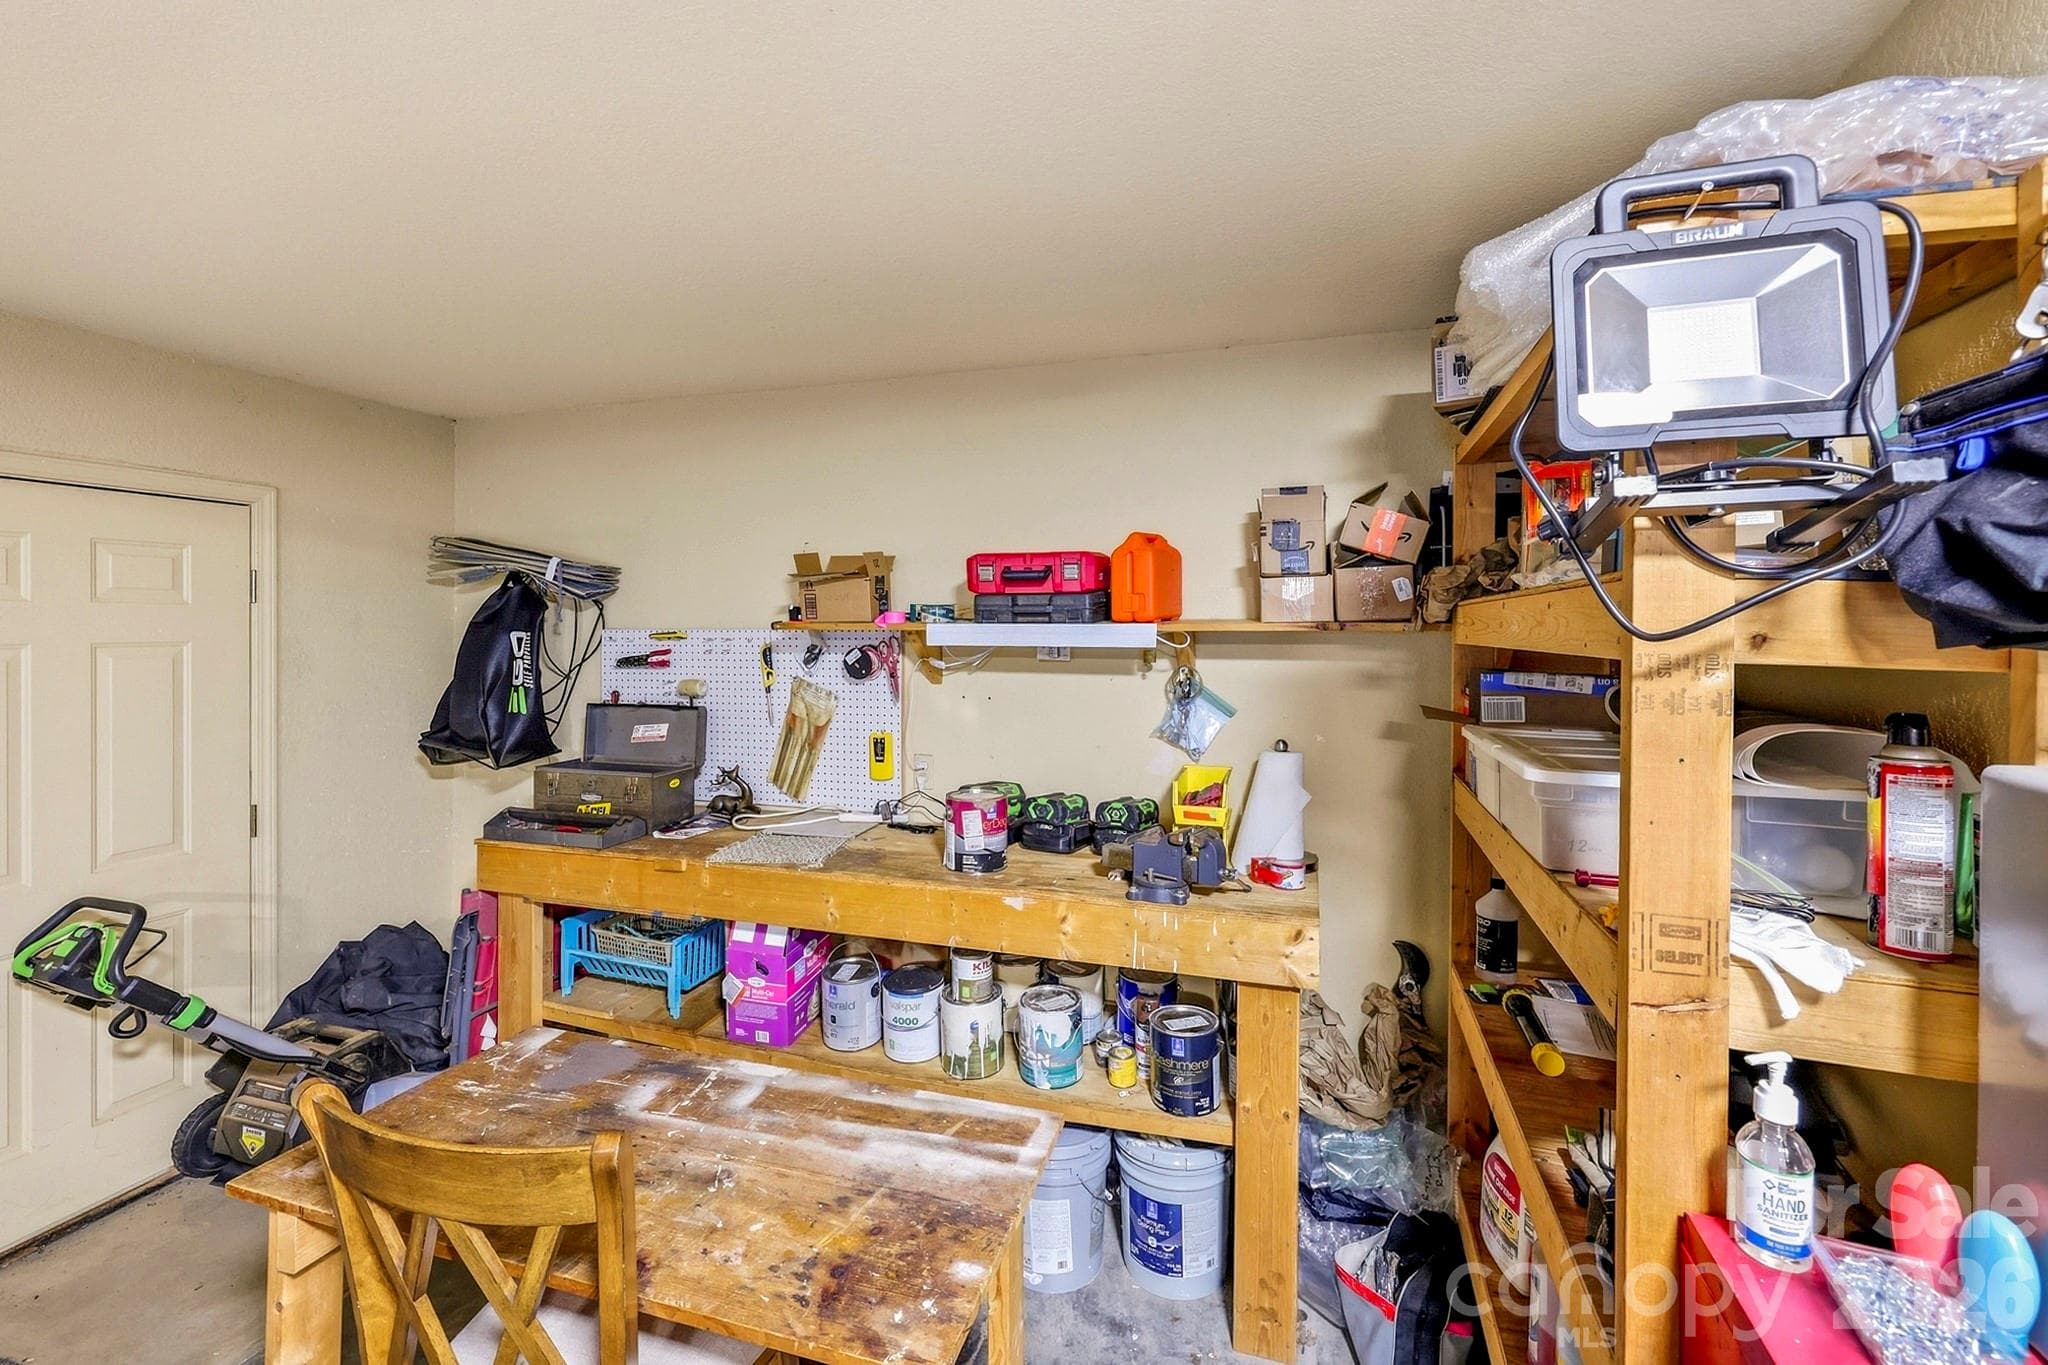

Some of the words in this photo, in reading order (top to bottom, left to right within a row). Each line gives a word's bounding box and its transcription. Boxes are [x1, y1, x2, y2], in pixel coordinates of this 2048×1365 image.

[1674, 222, 1744, 245] BRAUN
[1656, 652, 1672, 679] STUD
[1655, 949, 1704, 967] SELECT
[892, 1016, 919, 1026] 4000
[1762, 1191, 1806, 1214] HAND
